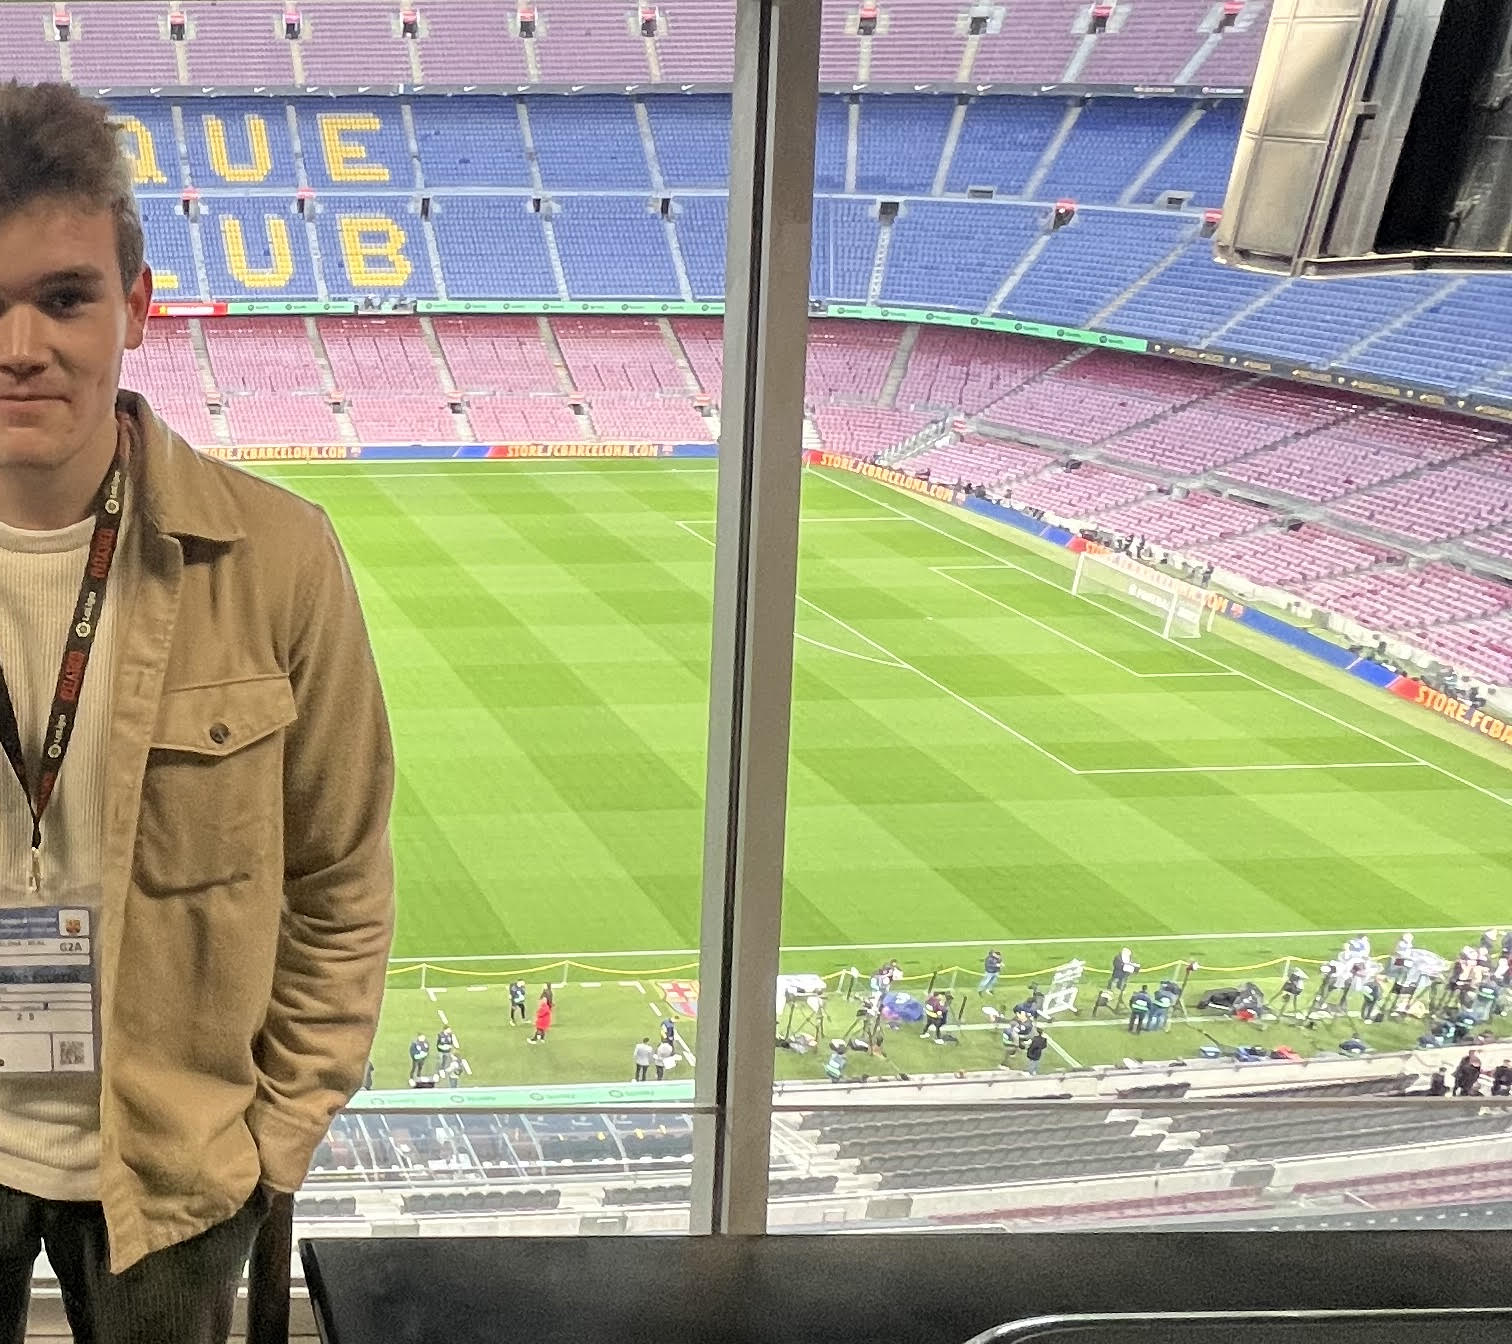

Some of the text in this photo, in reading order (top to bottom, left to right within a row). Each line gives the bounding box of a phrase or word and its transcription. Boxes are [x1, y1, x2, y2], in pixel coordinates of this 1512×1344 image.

[507, 444, 658, 457] STORE.FCBARCELONA.COM
[820, 453, 954, 502] STORE.FCBARCELONA.COM
[59, 942, 83, 952] G2A
